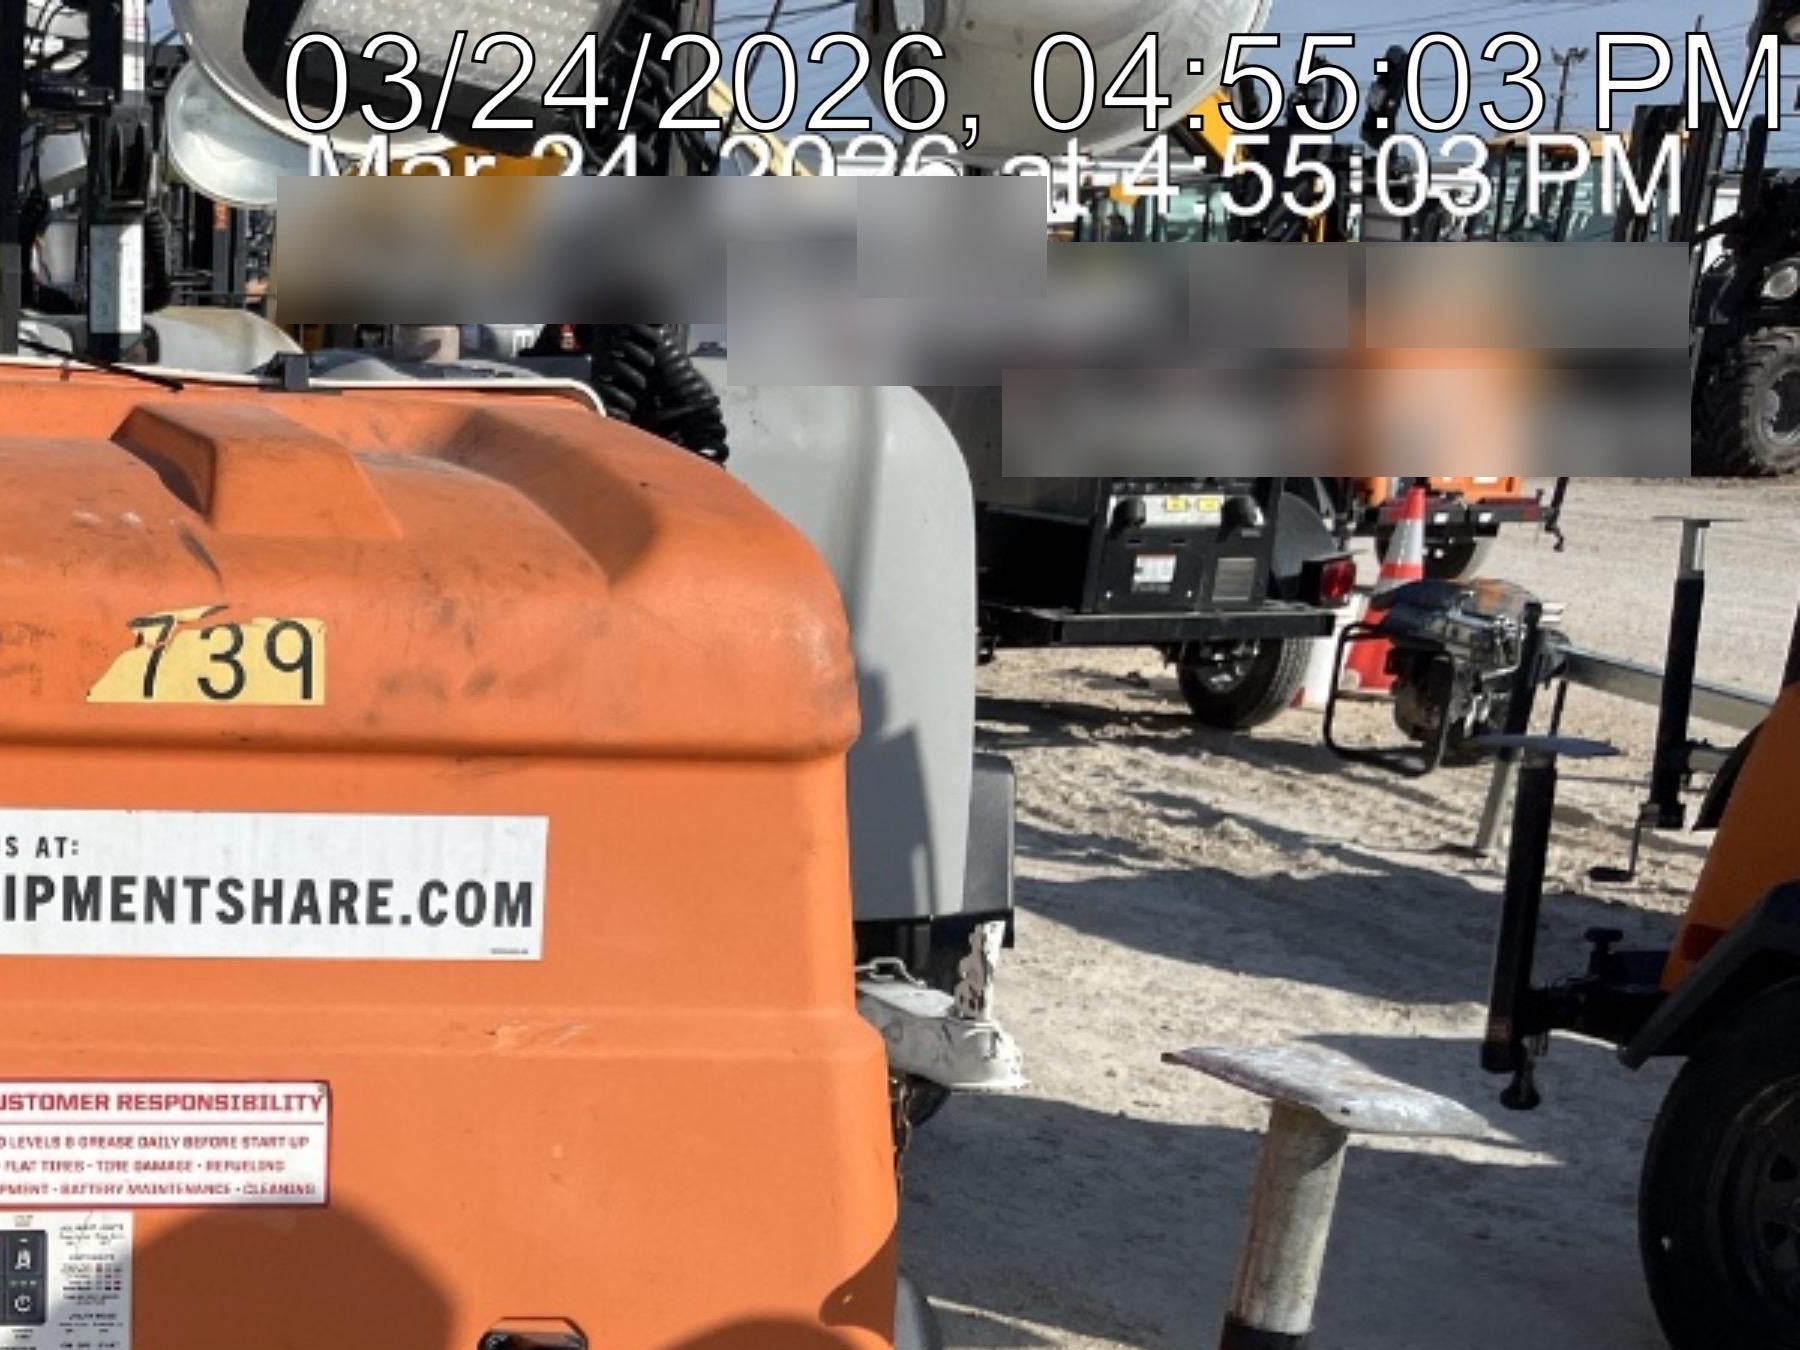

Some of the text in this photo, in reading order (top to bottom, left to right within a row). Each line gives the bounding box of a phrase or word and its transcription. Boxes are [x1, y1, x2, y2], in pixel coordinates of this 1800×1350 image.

[127, 613, 313, 701] 739
[35, 835, 80, 859] AT:
[116, 1093, 323, 1113] RESPONSIBILITY
[10, 1135, 61, 1150] LEVELS
[78, 1135, 134, 1150] GREASE
[137, 1135, 181, 1150] DAILY
[183, 1135, 238, 1150] BEFORE
[242, 1135, 287, 1150] START
[290, 1135, 310, 1150] UP
[5, 1160, 37, 1174] FLAT
